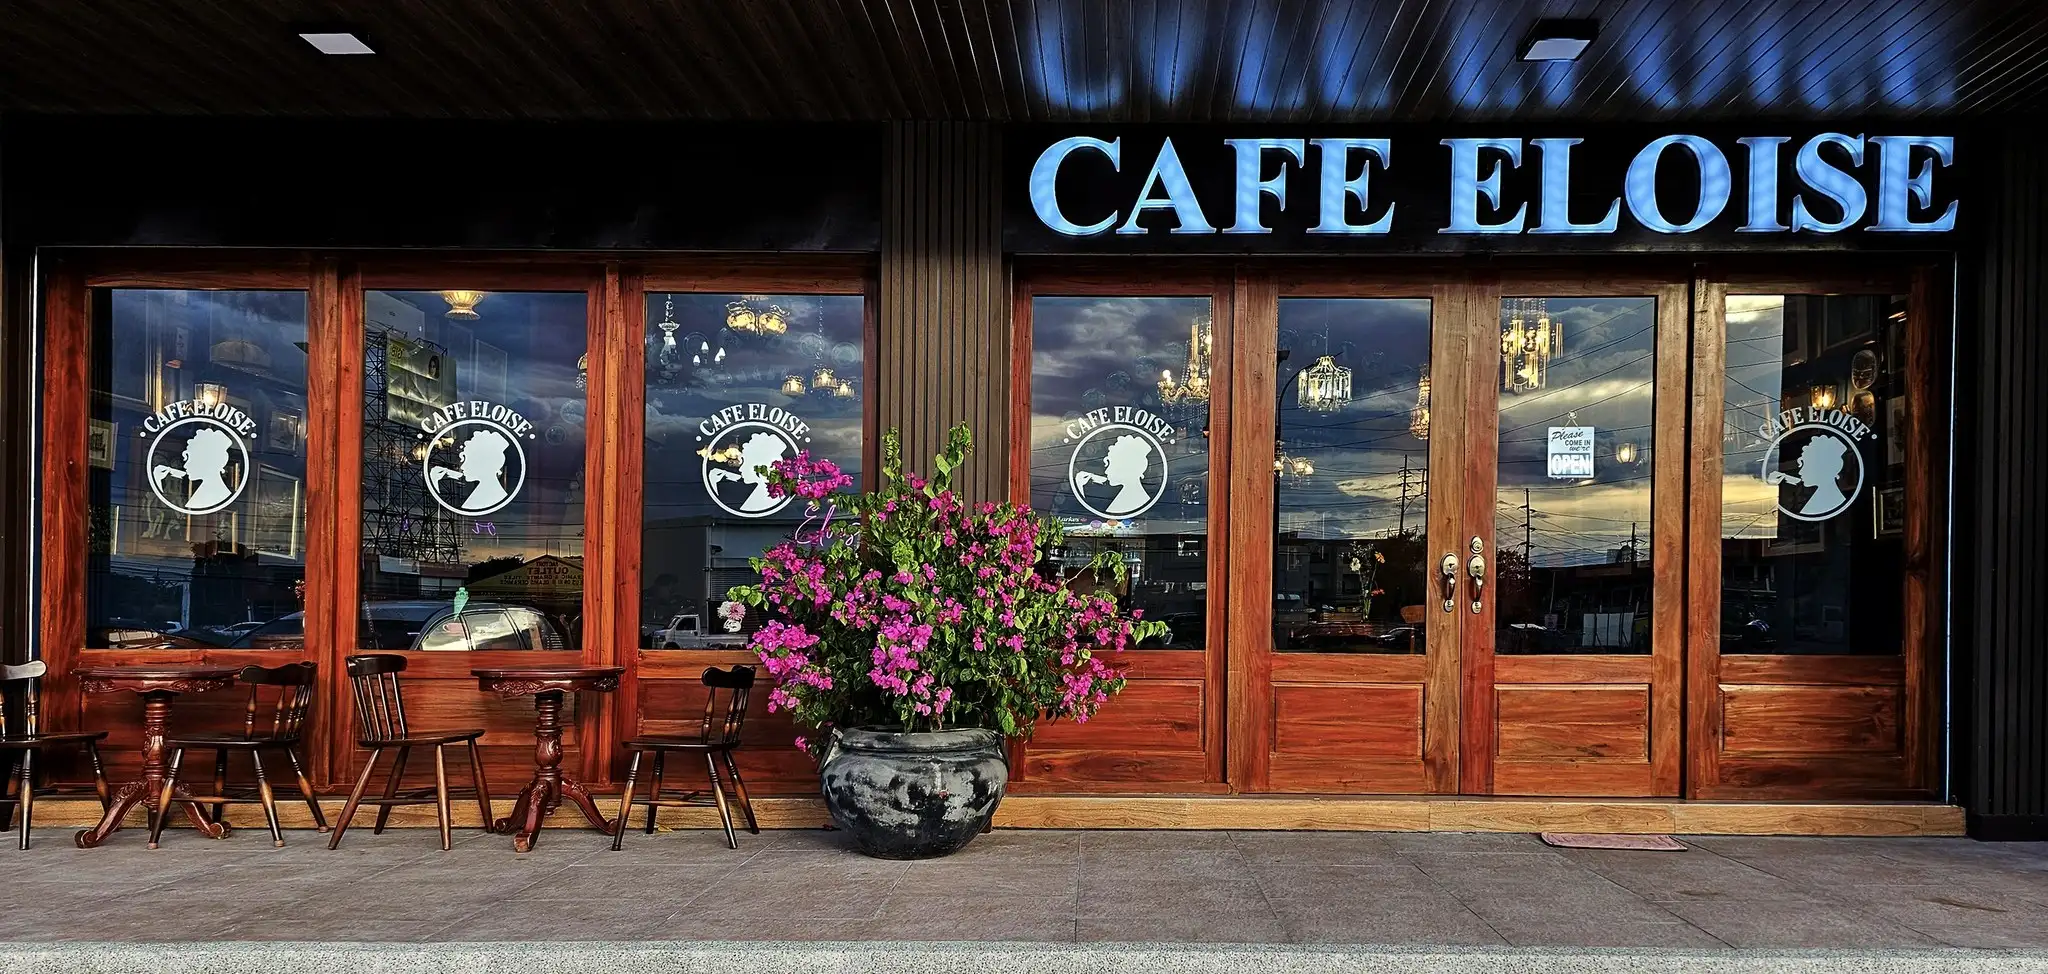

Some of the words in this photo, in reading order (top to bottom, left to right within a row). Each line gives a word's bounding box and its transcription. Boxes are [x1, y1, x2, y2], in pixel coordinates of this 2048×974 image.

[1029, 136, 1396, 236] CAFE
[1437, 132, 1959, 234] ELOISE
[144, 399, 190, 433] CAFE
[193, 398, 257, 436] ELOISE
[421, 401, 467, 434] CAFE
[470, 400, 533, 438] ELOISE
[699, 404, 745, 436] CAFE
[748, 403, 811, 440] ELOISE
[1066, 407, 1111, 440] CAFE
[1114, 406, 1175, 442] ELOISE
[1759, 406, 1805, 440] CAFE
[1808, 405, 1871, 442] ELOISE
[1551, 431, 1584, 442] Please
[1551, 454, 1590, 475] OPEN
